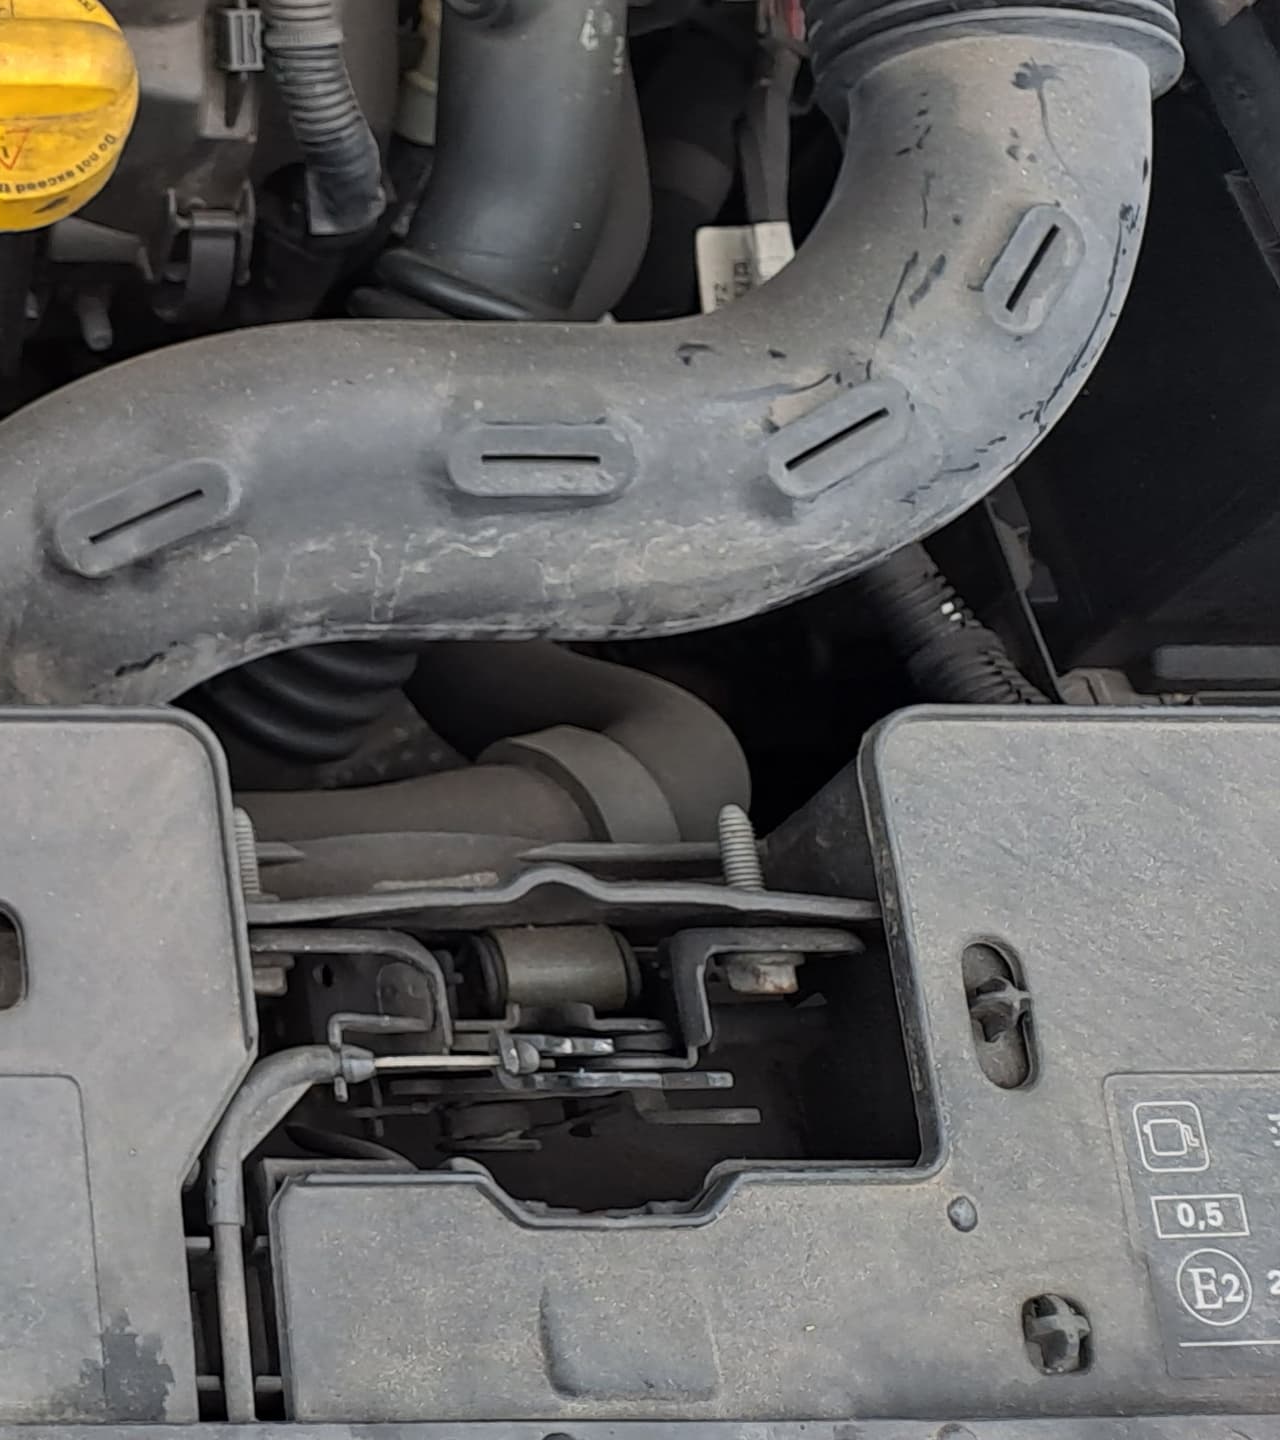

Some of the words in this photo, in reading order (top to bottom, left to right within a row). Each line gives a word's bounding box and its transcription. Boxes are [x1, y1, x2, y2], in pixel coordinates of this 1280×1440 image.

[98, 133, 117, 153] Do
[76, 151, 99, 174] not
[16, 170, 76, 194] exceed
[1176, 1201, 1224, 1231] 0,5
